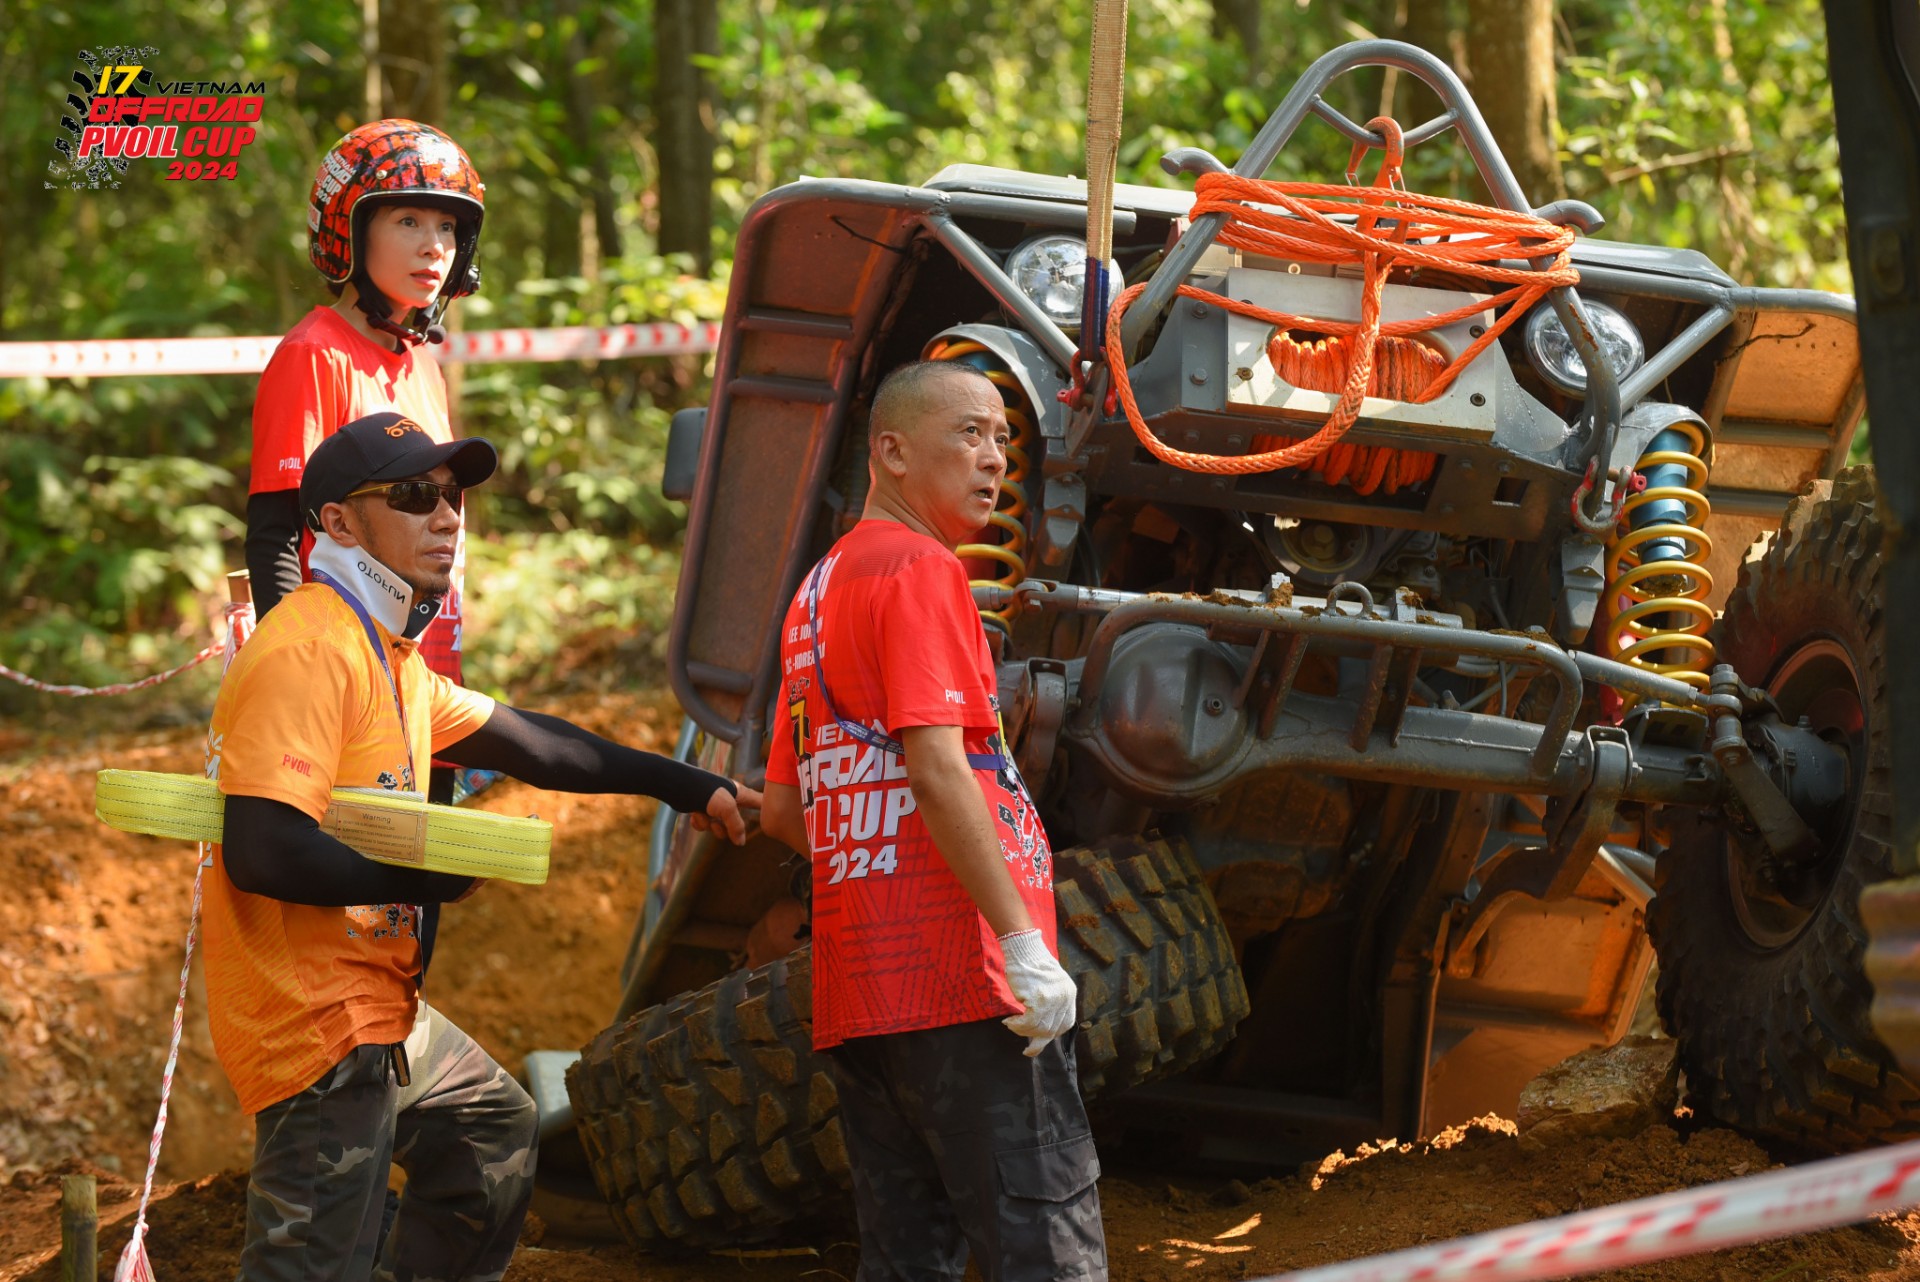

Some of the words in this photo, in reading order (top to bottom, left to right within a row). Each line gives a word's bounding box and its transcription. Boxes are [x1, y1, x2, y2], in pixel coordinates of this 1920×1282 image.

[322, 174, 342, 196] CUP
[282, 753, 311, 777] PVOIL
[362, 812, 392, 824] Warning
